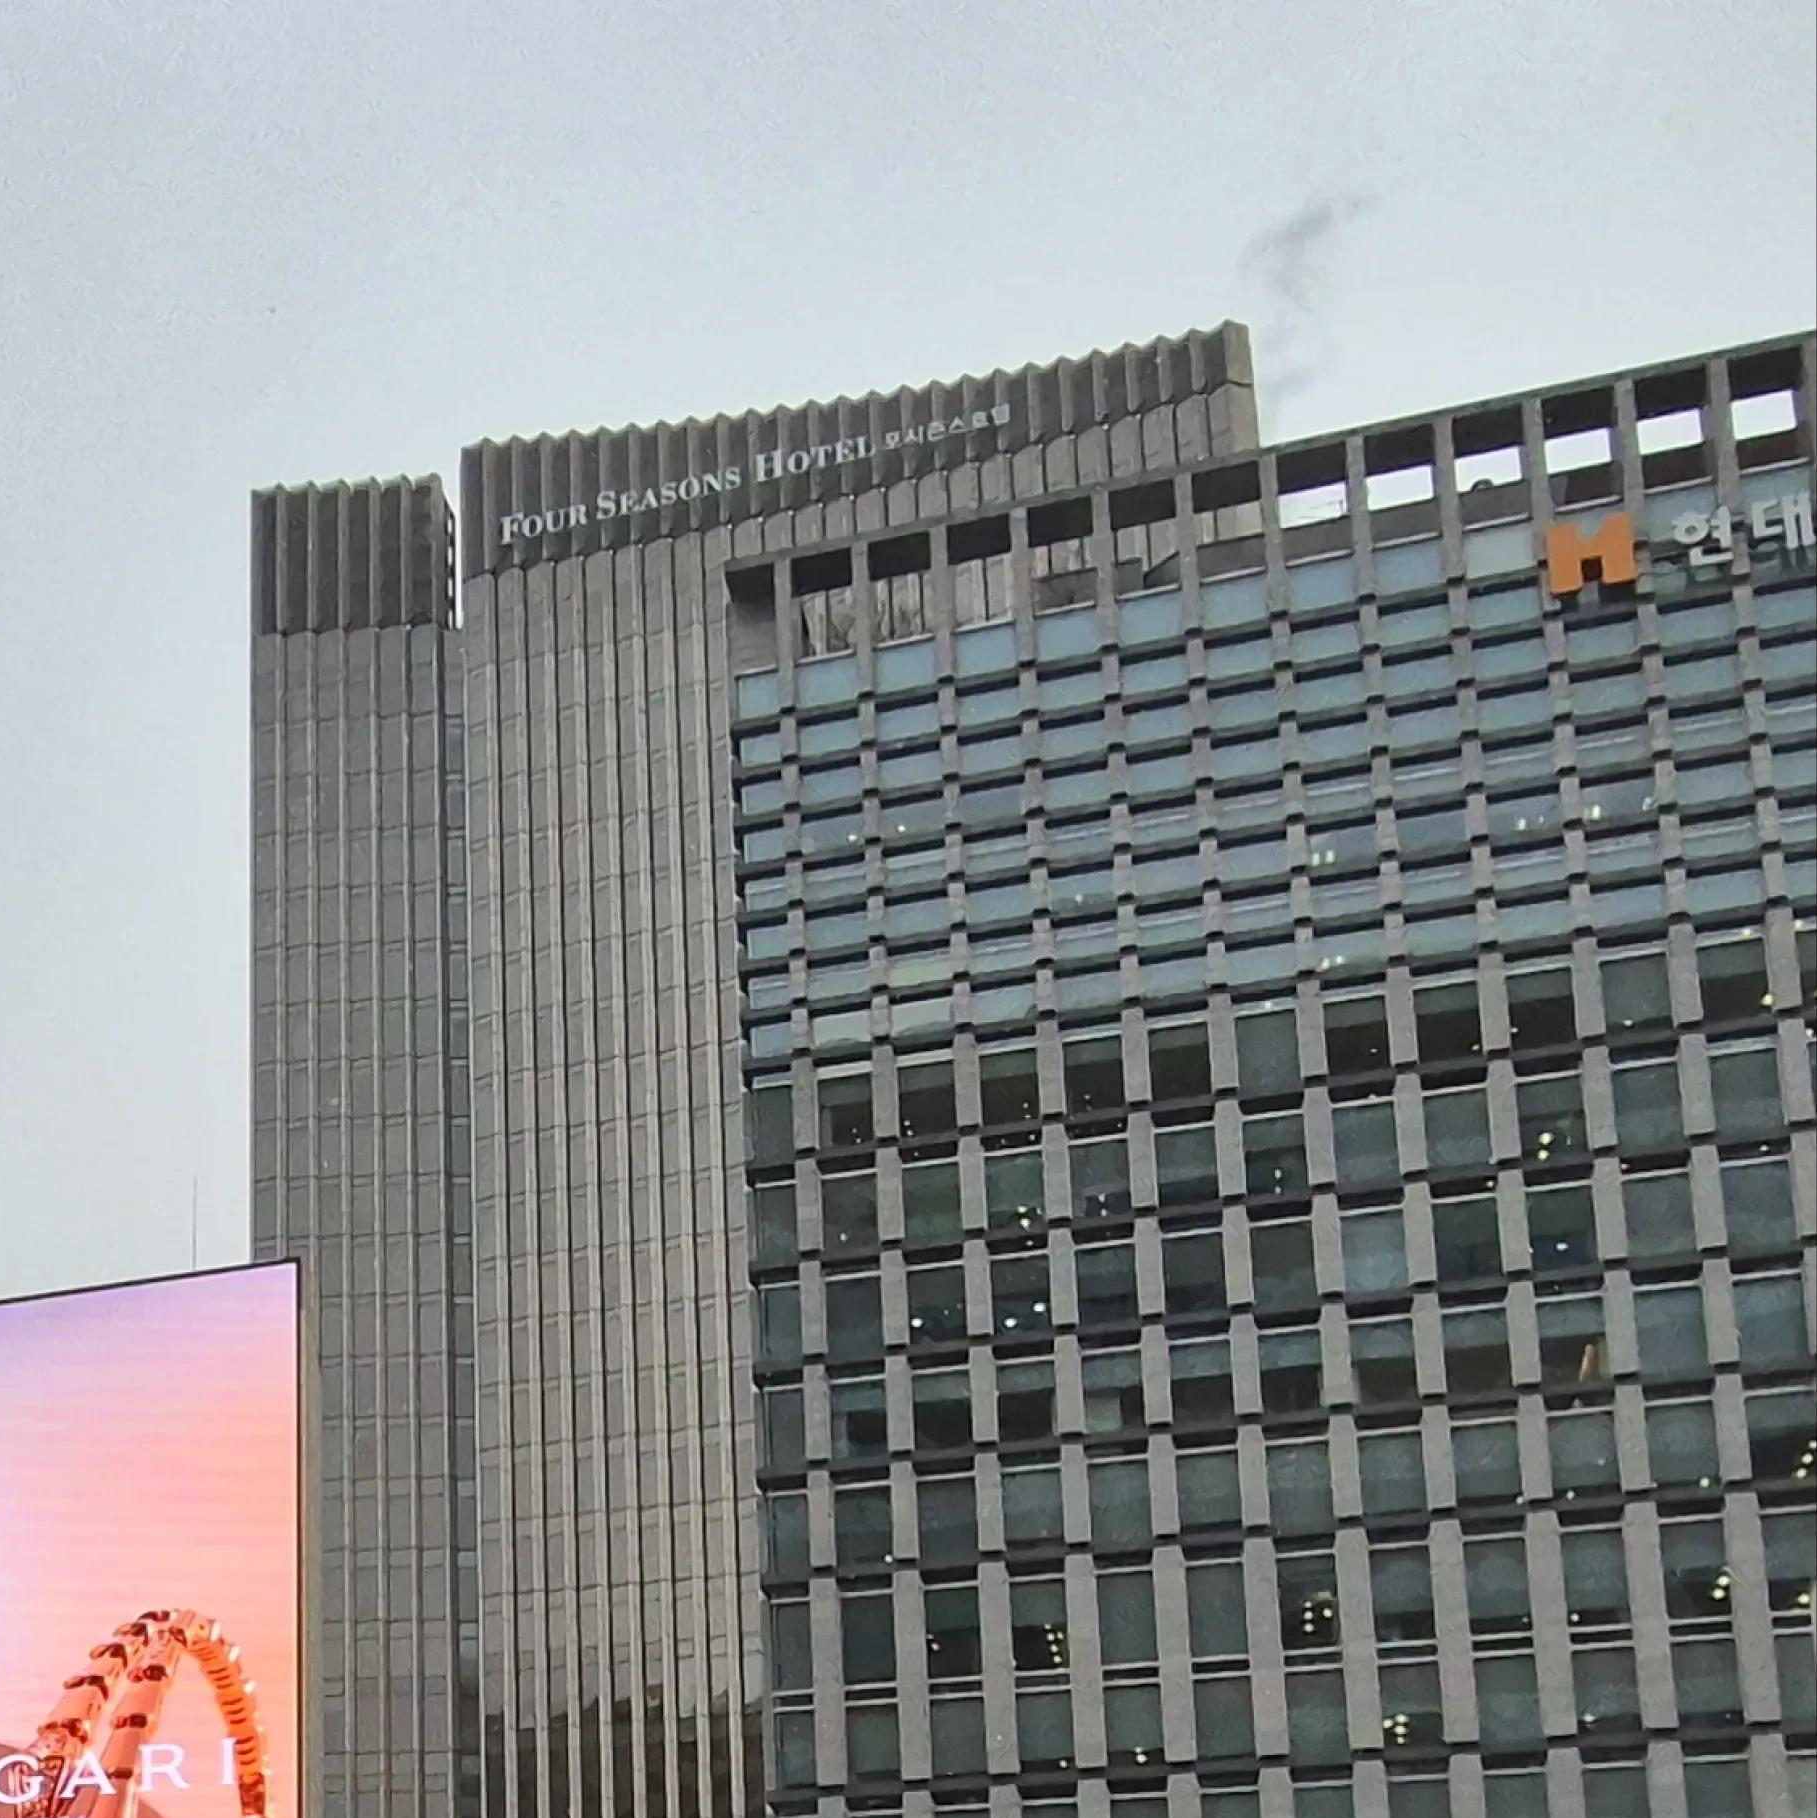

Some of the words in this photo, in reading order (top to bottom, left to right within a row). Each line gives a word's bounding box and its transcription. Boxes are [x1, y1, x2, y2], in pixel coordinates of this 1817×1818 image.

[500, 503, 588, 545] FOUR
[596, 466, 742, 520] SEASONS
[755, 435, 876, 482] HOTEL
